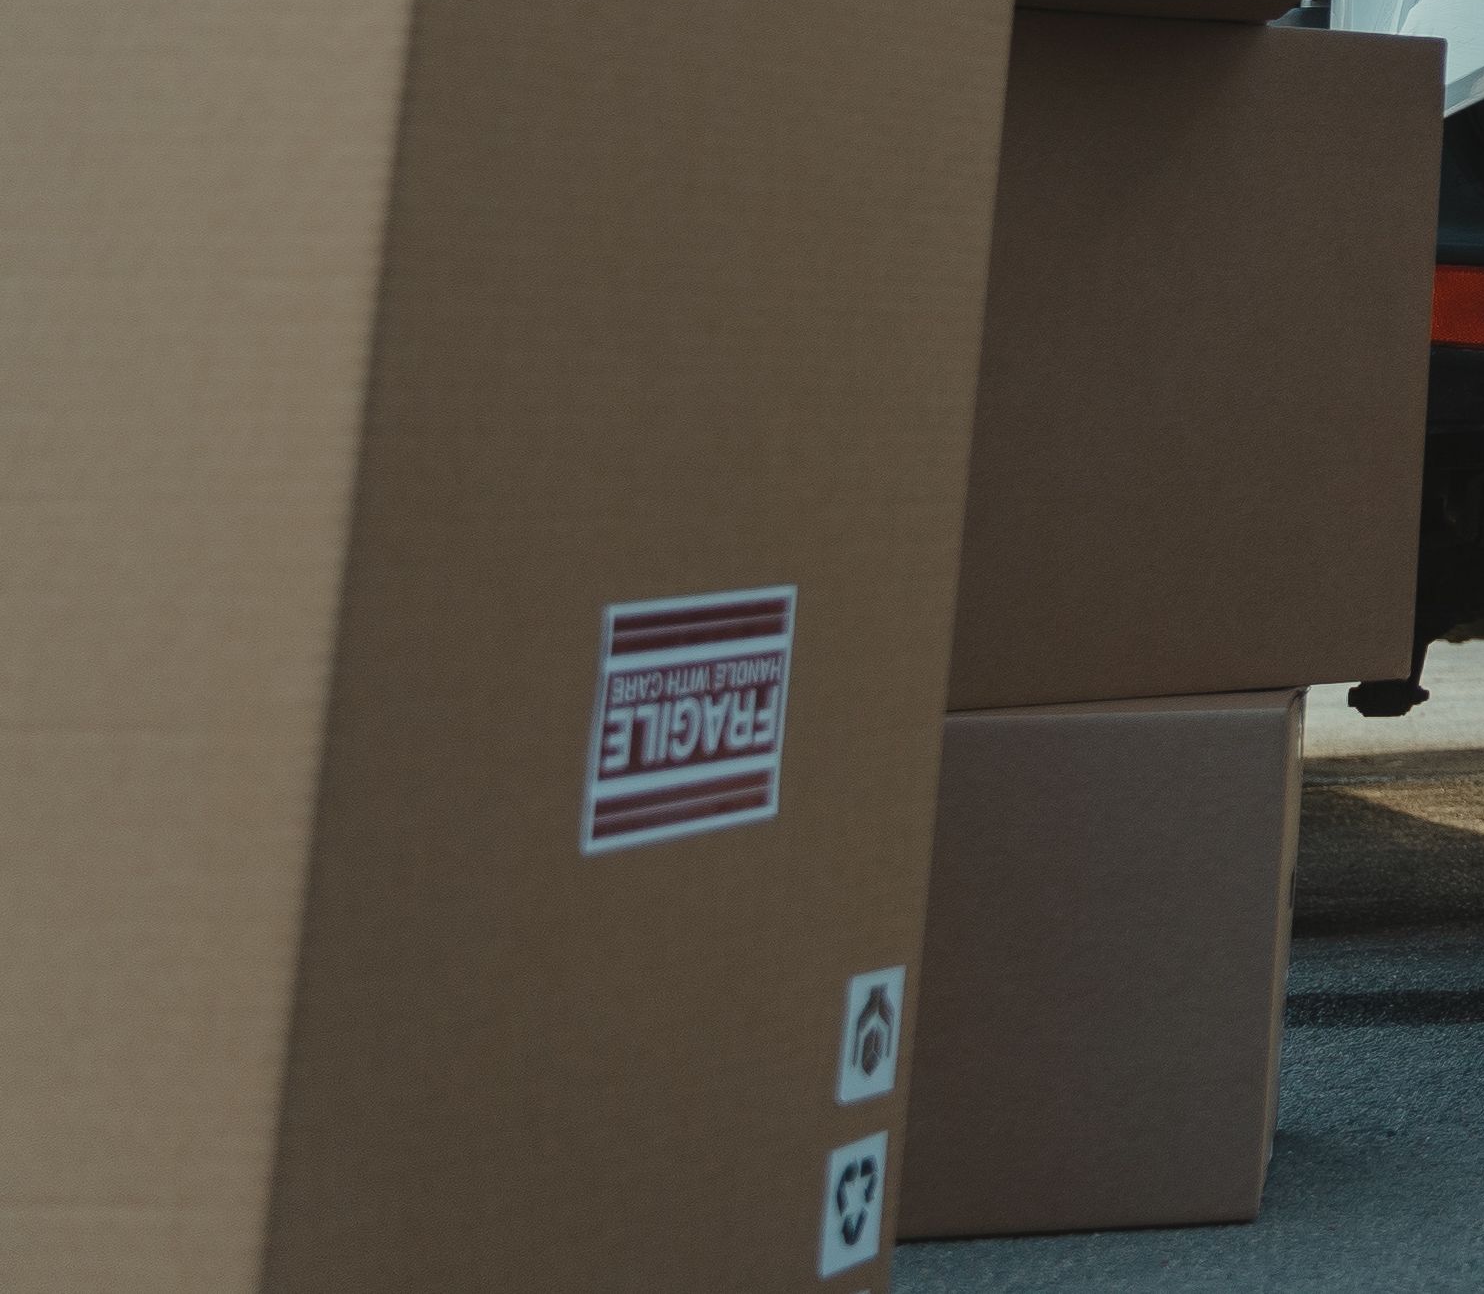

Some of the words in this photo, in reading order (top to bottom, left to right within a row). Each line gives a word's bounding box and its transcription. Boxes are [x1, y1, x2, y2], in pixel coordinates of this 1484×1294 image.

[666, 664, 711, 695] WITH
[716, 657, 784, 689] HANDLE
[611, 674, 664, 704] CARE
[603, 684, 780, 772] FRAGILE
